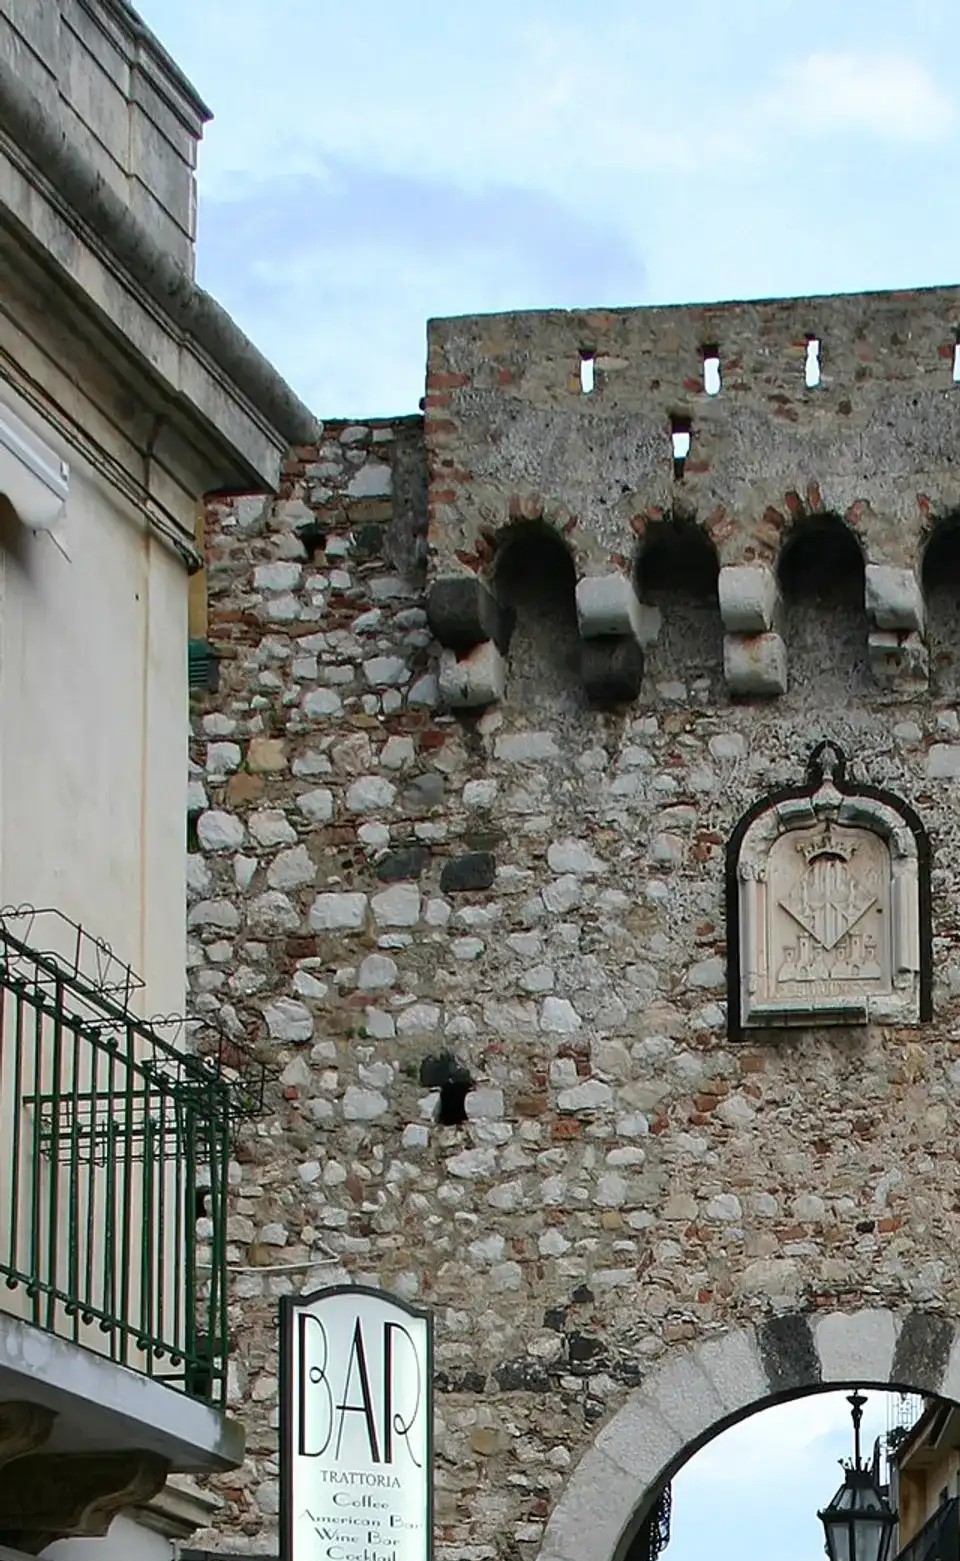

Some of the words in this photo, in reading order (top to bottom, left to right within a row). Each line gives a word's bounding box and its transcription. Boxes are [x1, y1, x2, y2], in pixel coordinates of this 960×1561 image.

[298, 1313, 422, 1467] BAR
[320, 1470, 401, 1488] TRATTORIA
[333, 1492, 389, 1509] Coffee
[299, 1509, 381, 1527] American
[390, 1515, 423, 1528] Bar
[314, 1527, 359, 1543] Wine
[368, 1531, 400, 1545] Bar
